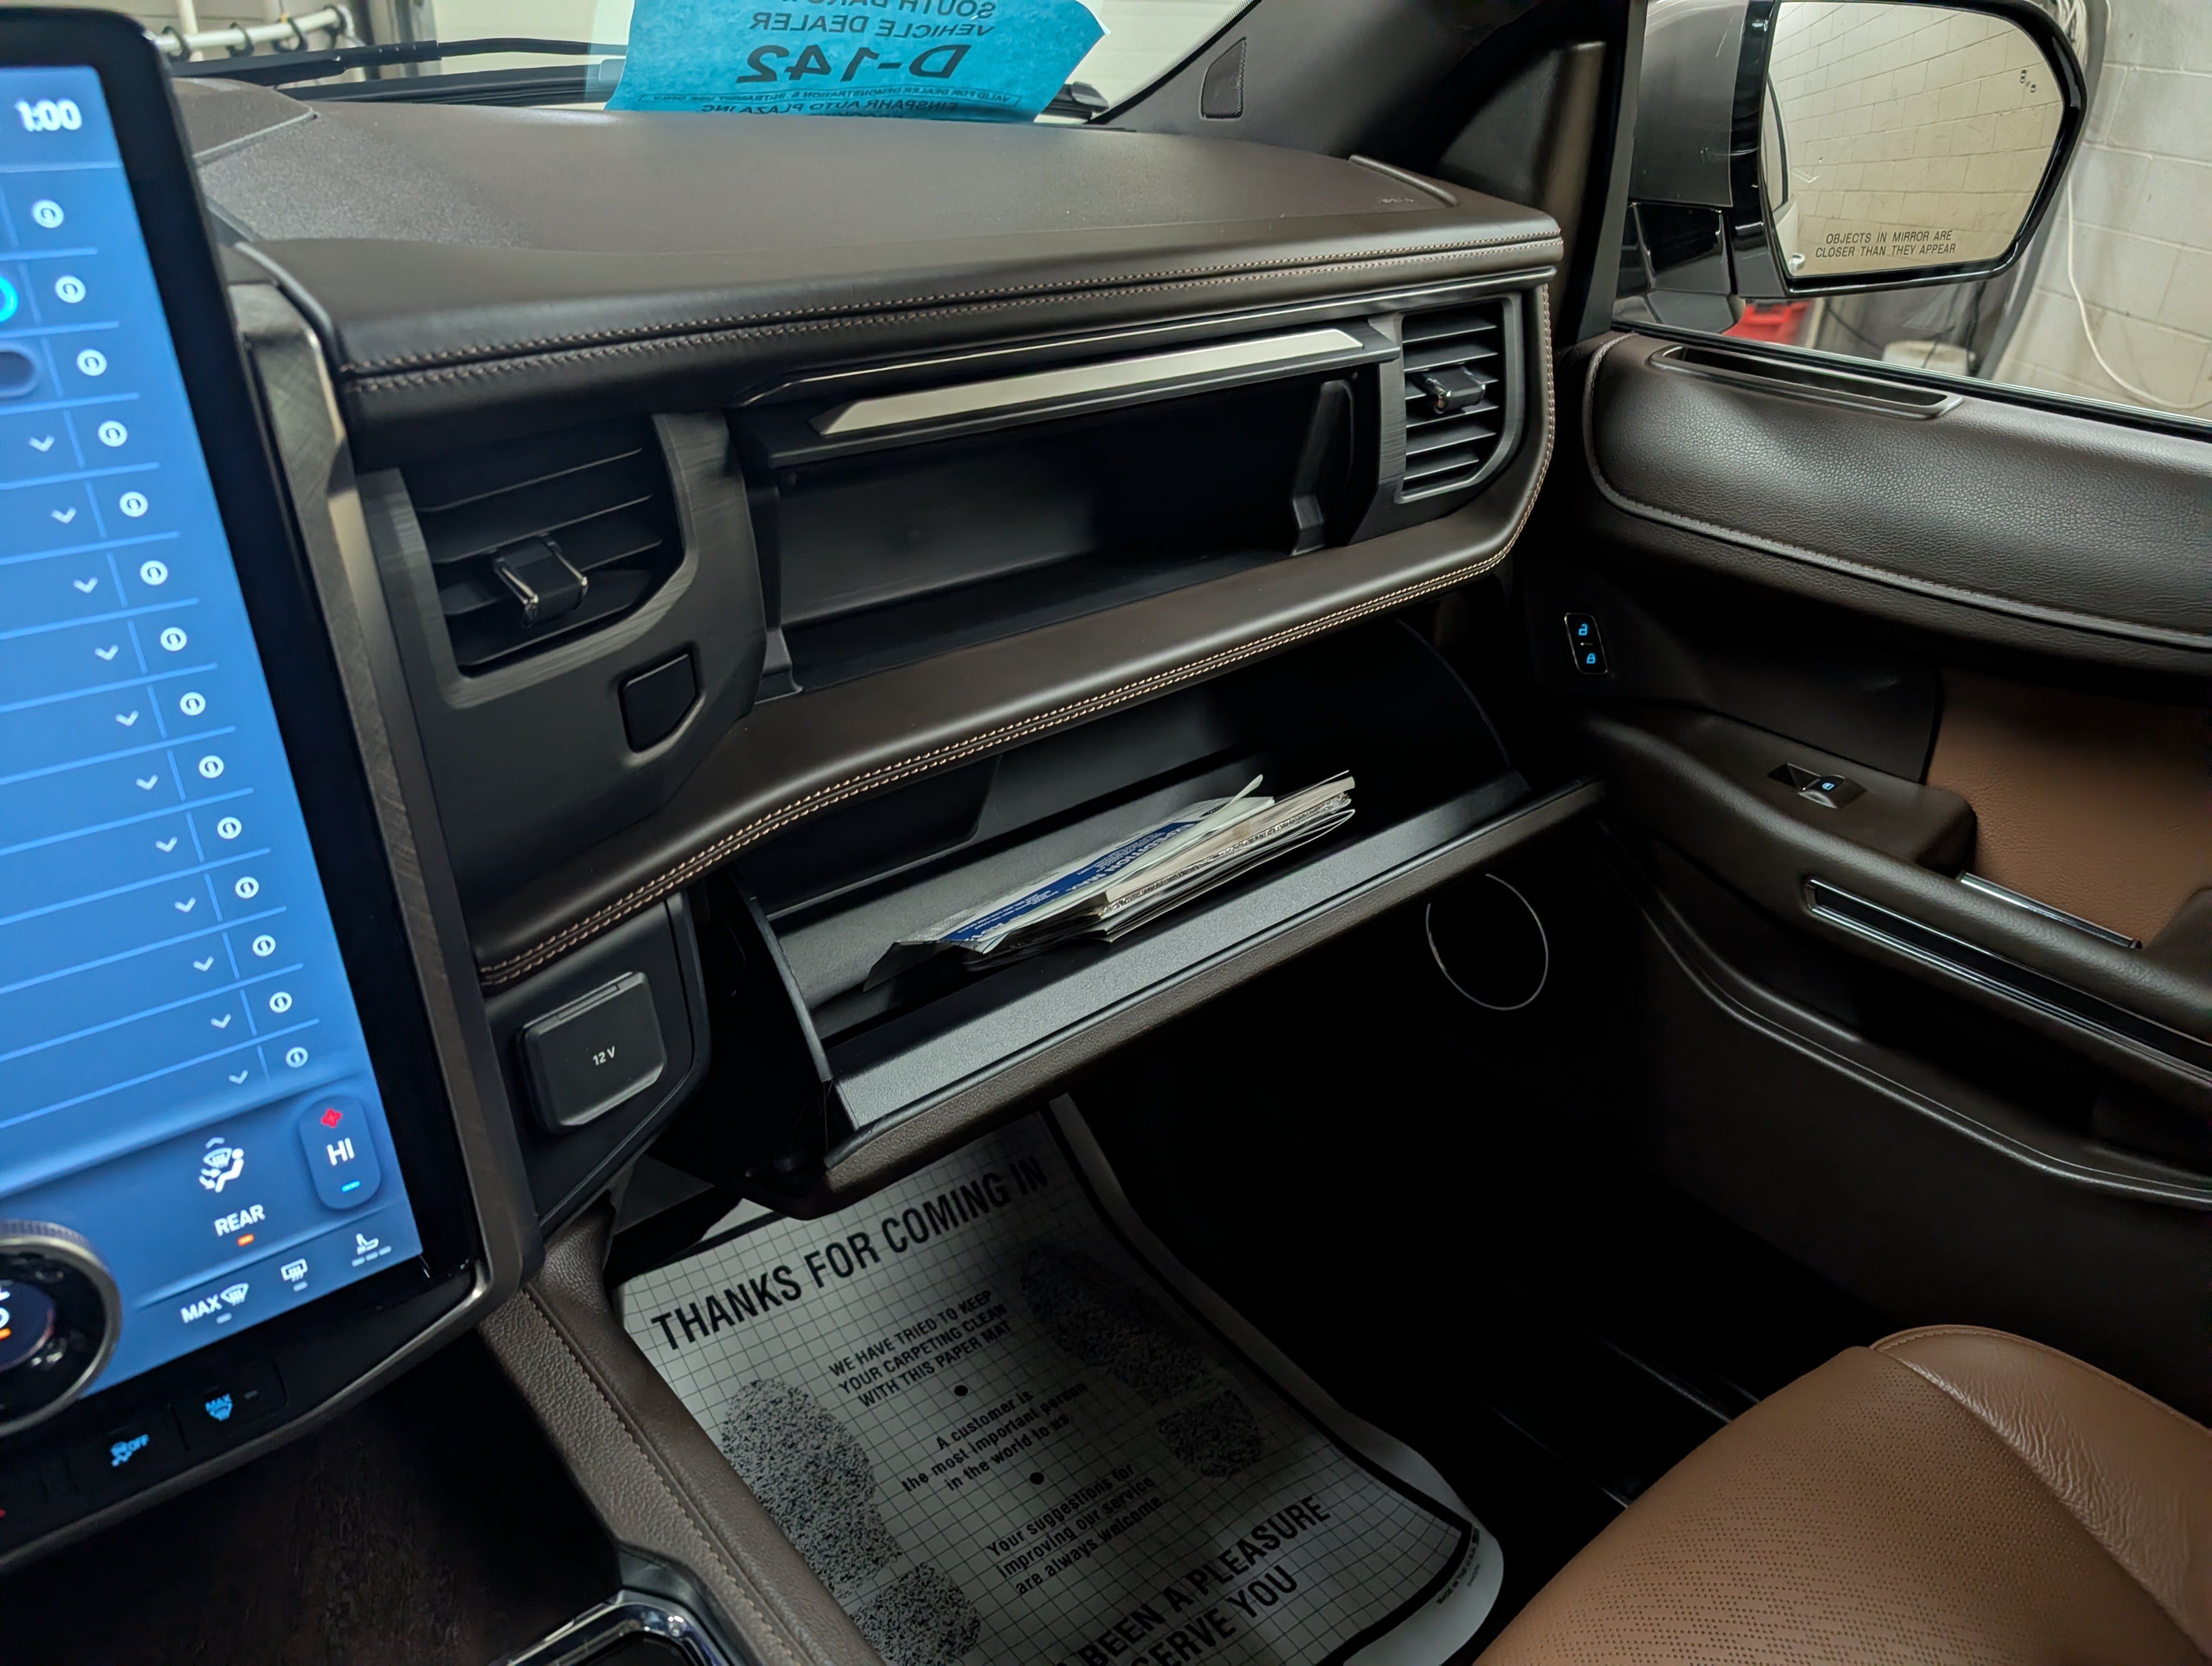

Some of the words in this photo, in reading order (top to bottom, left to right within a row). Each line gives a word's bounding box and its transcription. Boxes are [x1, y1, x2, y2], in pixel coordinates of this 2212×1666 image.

[15, 99, 82, 132] 1:00
[1815, 247, 1855, 258] CLOSER
[1860, 246, 1887, 257] THAN
[1891, 244, 1917, 255] THEY
[1919, 243, 1957, 255] APPEAR
[1825, 232, 1872, 244] OBJECTS
[1876, 232, 1889, 243] IN
[1892, 230, 1930, 242] MIRROR
[1933, 230, 1953, 241] ARE
[592, 1050, 607, 1066] 12
[606, 1045, 616, 1059] V
[326, 1137, 355, 1165] HI
[214, 1203, 266, 1236] REAR
[651, 1265, 802, 1350] THANKS
[804, 1231, 880, 1288] FOR
[882, 1171, 1011, 1253] COMING
[1009, 1155, 1049, 1195] IN
[181, 1295, 223, 1324] MAX
[828, 1357, 856, 1376] WE
[856, 1337, 895, 1365] HAVE
[895, 1318, 937, 1345] TRIED
[937, 1308, 958, 1324] TO
[958, 1290, 991, 1314] KEEP
[839, 1366, 883, 1394] YOUR
[883, 1328, 962, 1373] CARPETING
[962, 1303, 1007, 1332] CLEAN
[858, 1380, 900, 1407] WITH
[898, 1361, 935, 1385] THIS
[935, 1336, 982, 1368] PAPER
[981, 1319, 1011, 1343] MAT
[205, 1393, 232, 1412] MAX
[936, 1437, 950, 1450] A
[951, 1400, 1016, 1441] customer
[1015, 1391, 1034, 1405] is
[902, 1472, 929, 1492] the
[931, 1448, 969, 1476] most
[968, 1408, 1040, 1454] important
[1039, 1382, 1088, 1416] person
[944, 1477, 964, 1491] in
[963, 1460, 990, 1480] the
[990, 1433, 1033, 1464] world
[1031, 1426, 1050, 1440] to
[1051, 1414, 1070, 1431] us
[987, 1530, 1025, 1556] Your
[1026, 1478, 1113, 1535] suggestions
[1111, 1463, 1135, 1482] for
[995, 1526, 1078, 1578] improving
[1076, 1509, 1101, 1530] our
[1102, 1477, 1155, 1514] service
[1015, 1573, 1043, 1595] are
[1044, 1538, 1098, 1577] always
[1097, 1496, 1163, 1542] welcome
[1077, 1603, 1166, 1666] BEEN
[1162, 1587, 1194, 1613] A
[1184, 1495, 1330, 1595] PLEASURE
[1227, 1565, 1297, 1618] YOU
